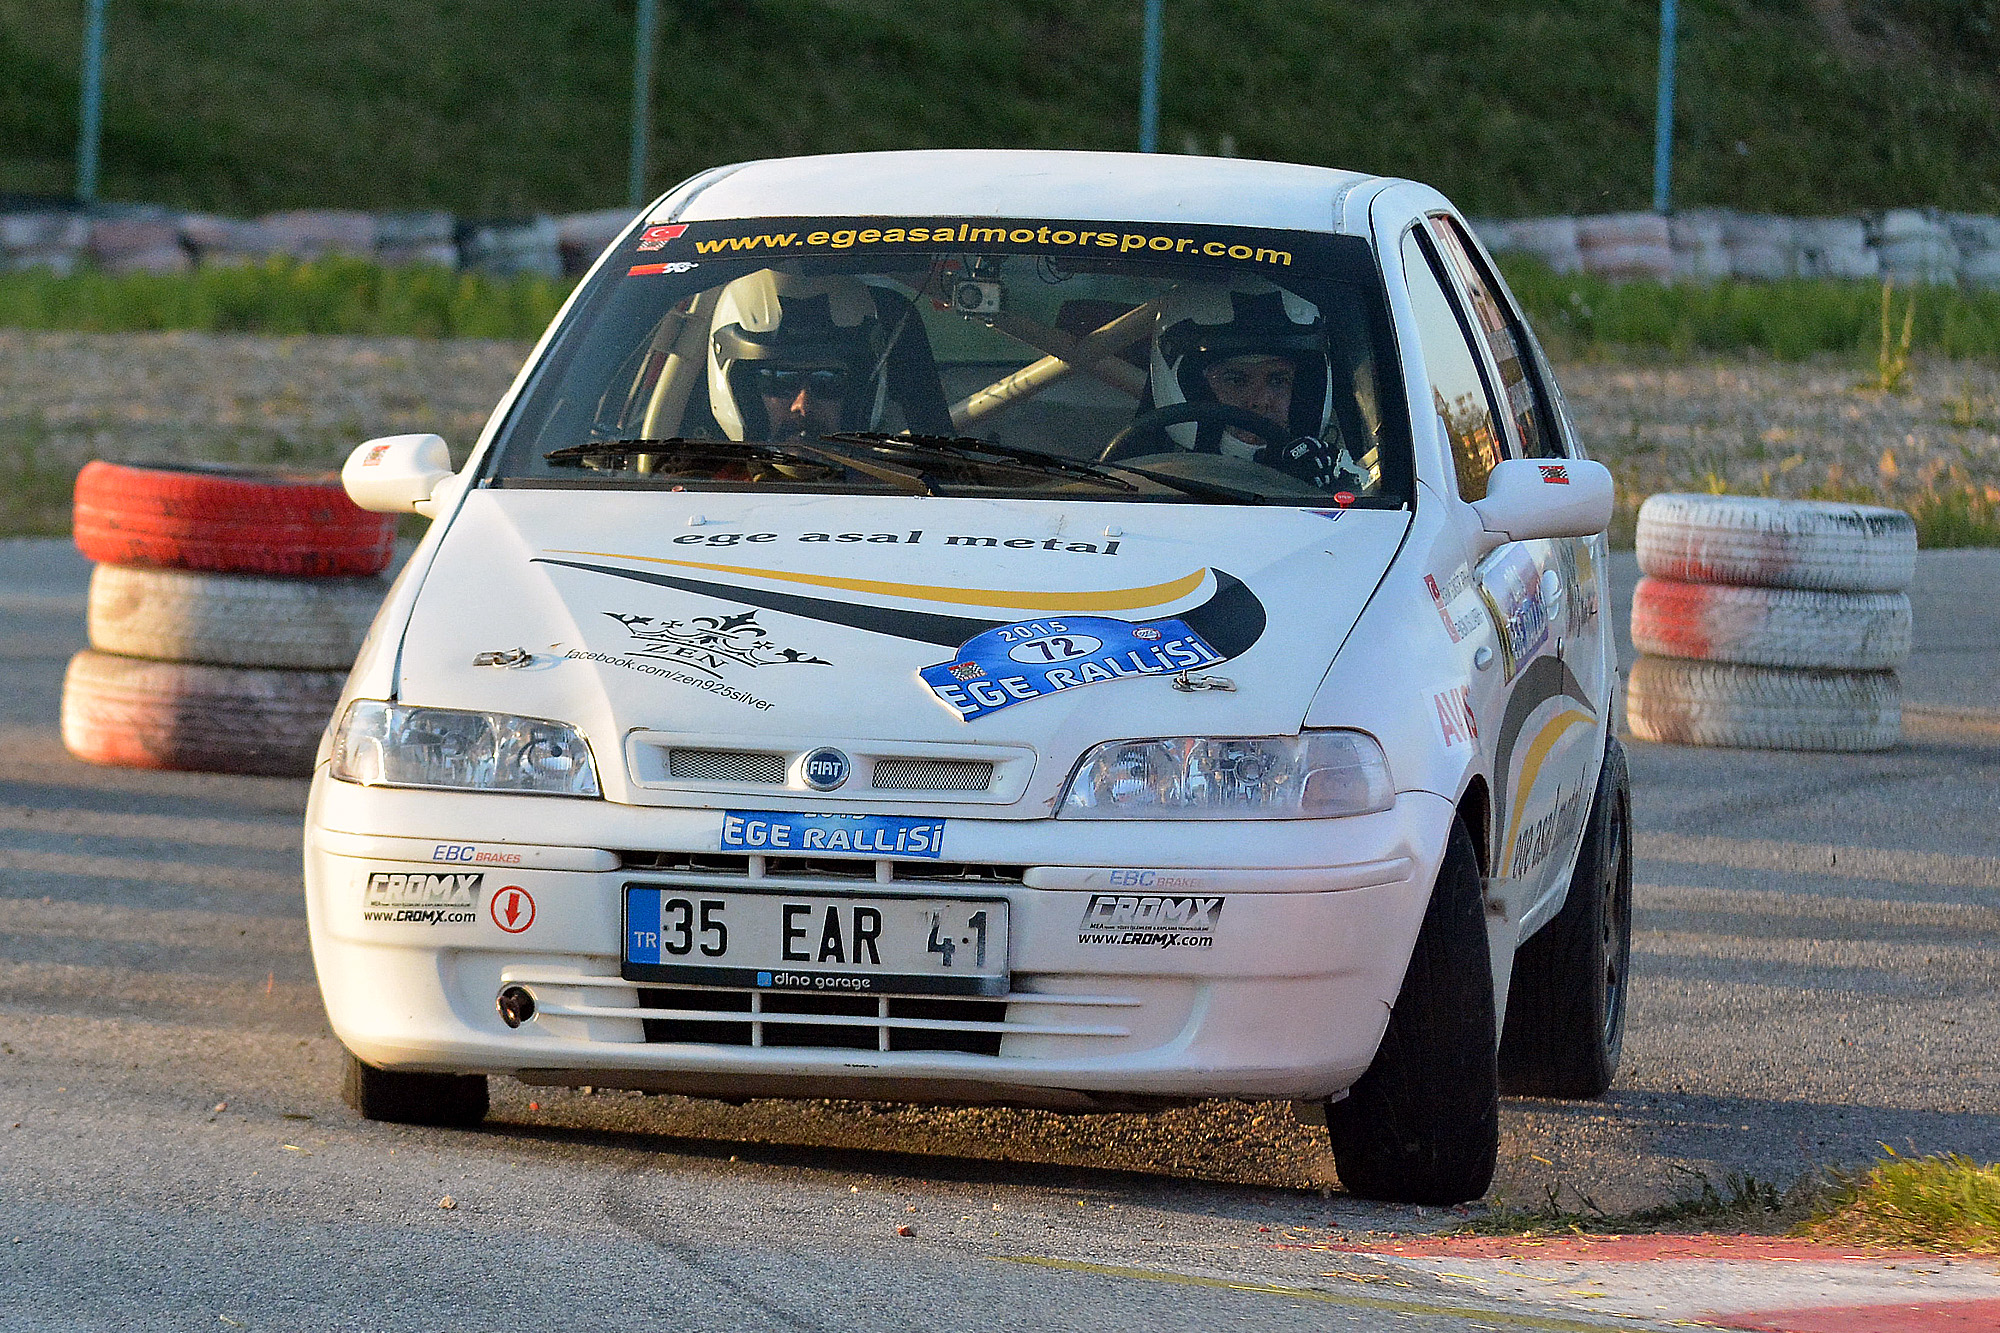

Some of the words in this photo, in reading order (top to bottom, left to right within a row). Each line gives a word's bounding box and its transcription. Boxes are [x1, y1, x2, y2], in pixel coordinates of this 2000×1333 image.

[695, 223, 1292, 266] www.egeasalmotorspor.com
[672, 530, 778, 547] ege
[798, 530, 923, 545] asal
[943, 535, 1121, 556] metal
[997, 621, 1069, 642] 2015
[642, 643, 729, 669] ZEN
[1026, 636, 1086, 661] 72
[564, 648, 775, 713] facebook.com/zen925silver
[933, 675, 1042, 714] EGE
[809, 760, 843, 778] FIAT
[723, 816, 791, 847] EGE
[433, 845, 475, 861] EBC
[475, 852, 522, 864] BRAKES
[1109, 870, 1155, 886] EBC
[1156, 877, 1204, 888] BRAKE
[364, 910, 476, 926] www.CROMX.com
[634, 931, 657, 948] TR
[664, 898, 728, 957] 35
[782, 903, 883, 964] EAR
[925, 910, 988, 967] 41
[1078, 932, 1213, 949] www.CROMX.com
[774, 973, 811, 986] dino
[815, 976, 871, 991] garage
